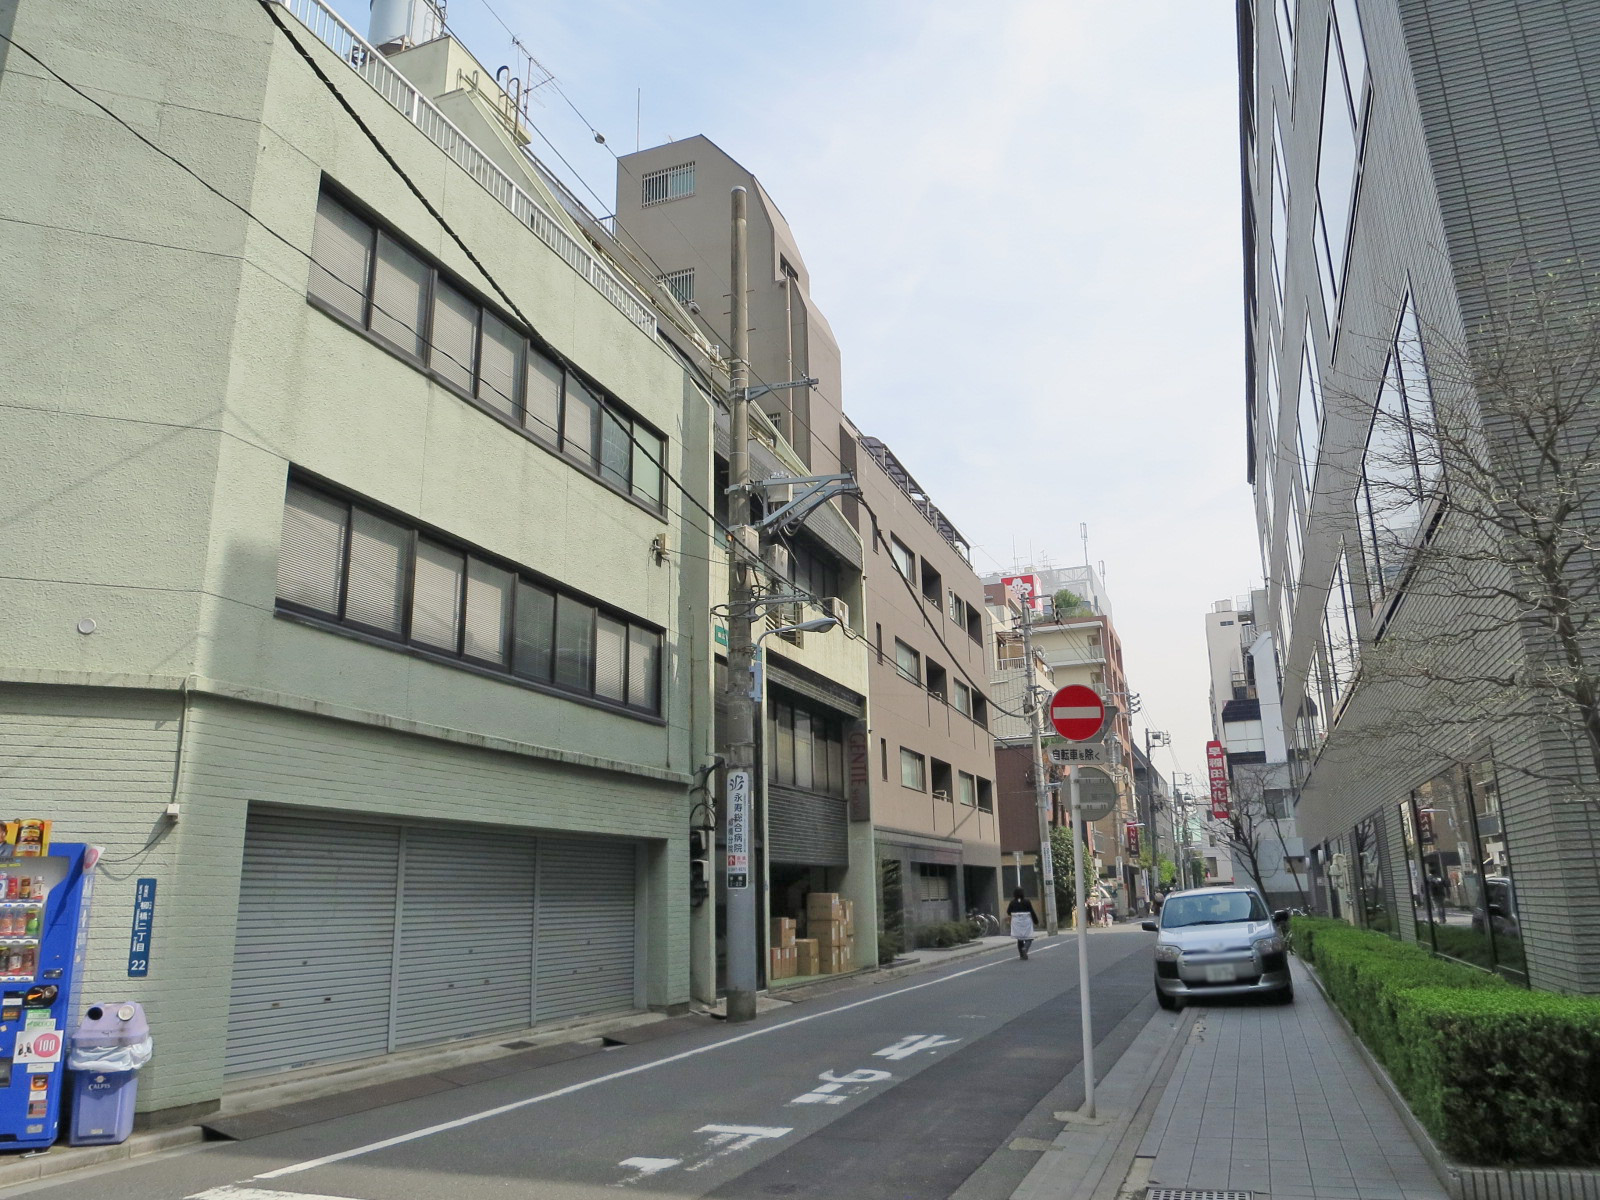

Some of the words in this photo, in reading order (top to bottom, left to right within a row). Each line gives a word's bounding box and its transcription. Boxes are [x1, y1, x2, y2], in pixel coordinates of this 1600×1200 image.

[1052, 748, 1101, 761] 自転車を除く
[733, 792, 743, 853] 永寿総合病院
[131, 959, 146, 970] 22
[38, 1039, 56, 1052] 100
